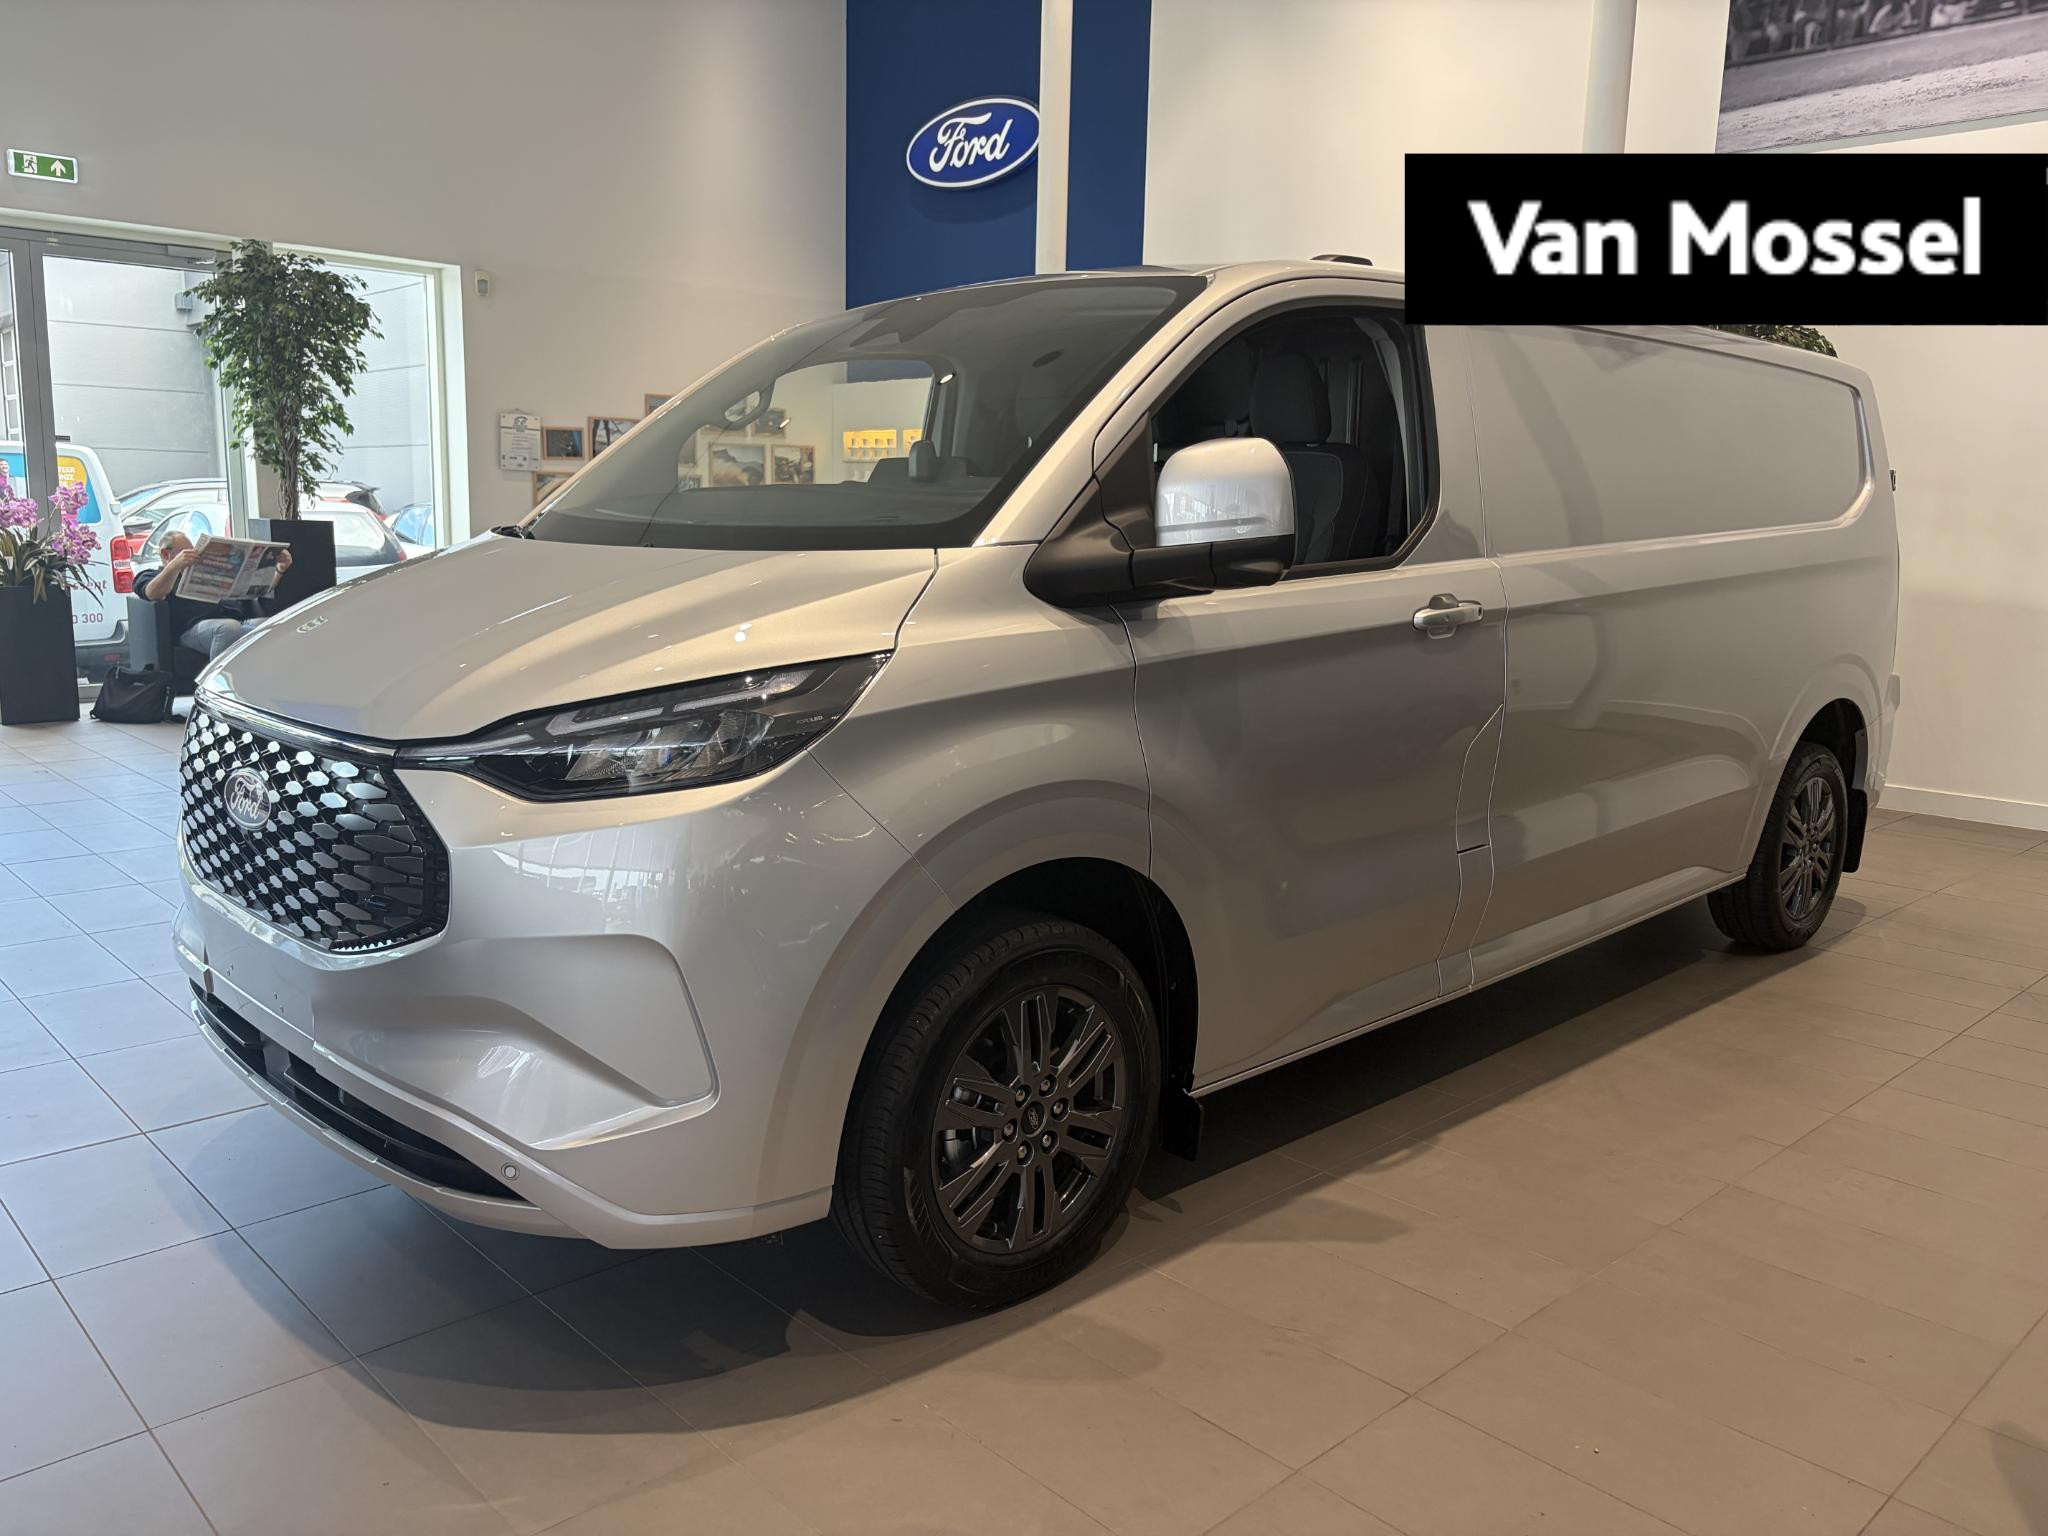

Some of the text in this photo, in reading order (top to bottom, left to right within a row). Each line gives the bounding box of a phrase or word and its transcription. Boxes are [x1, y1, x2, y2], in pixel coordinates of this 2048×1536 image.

[929, 112, 1013, 172] Ford
[81, 612, 104, 624] 300
[230, 776, 263, 820] Ford
